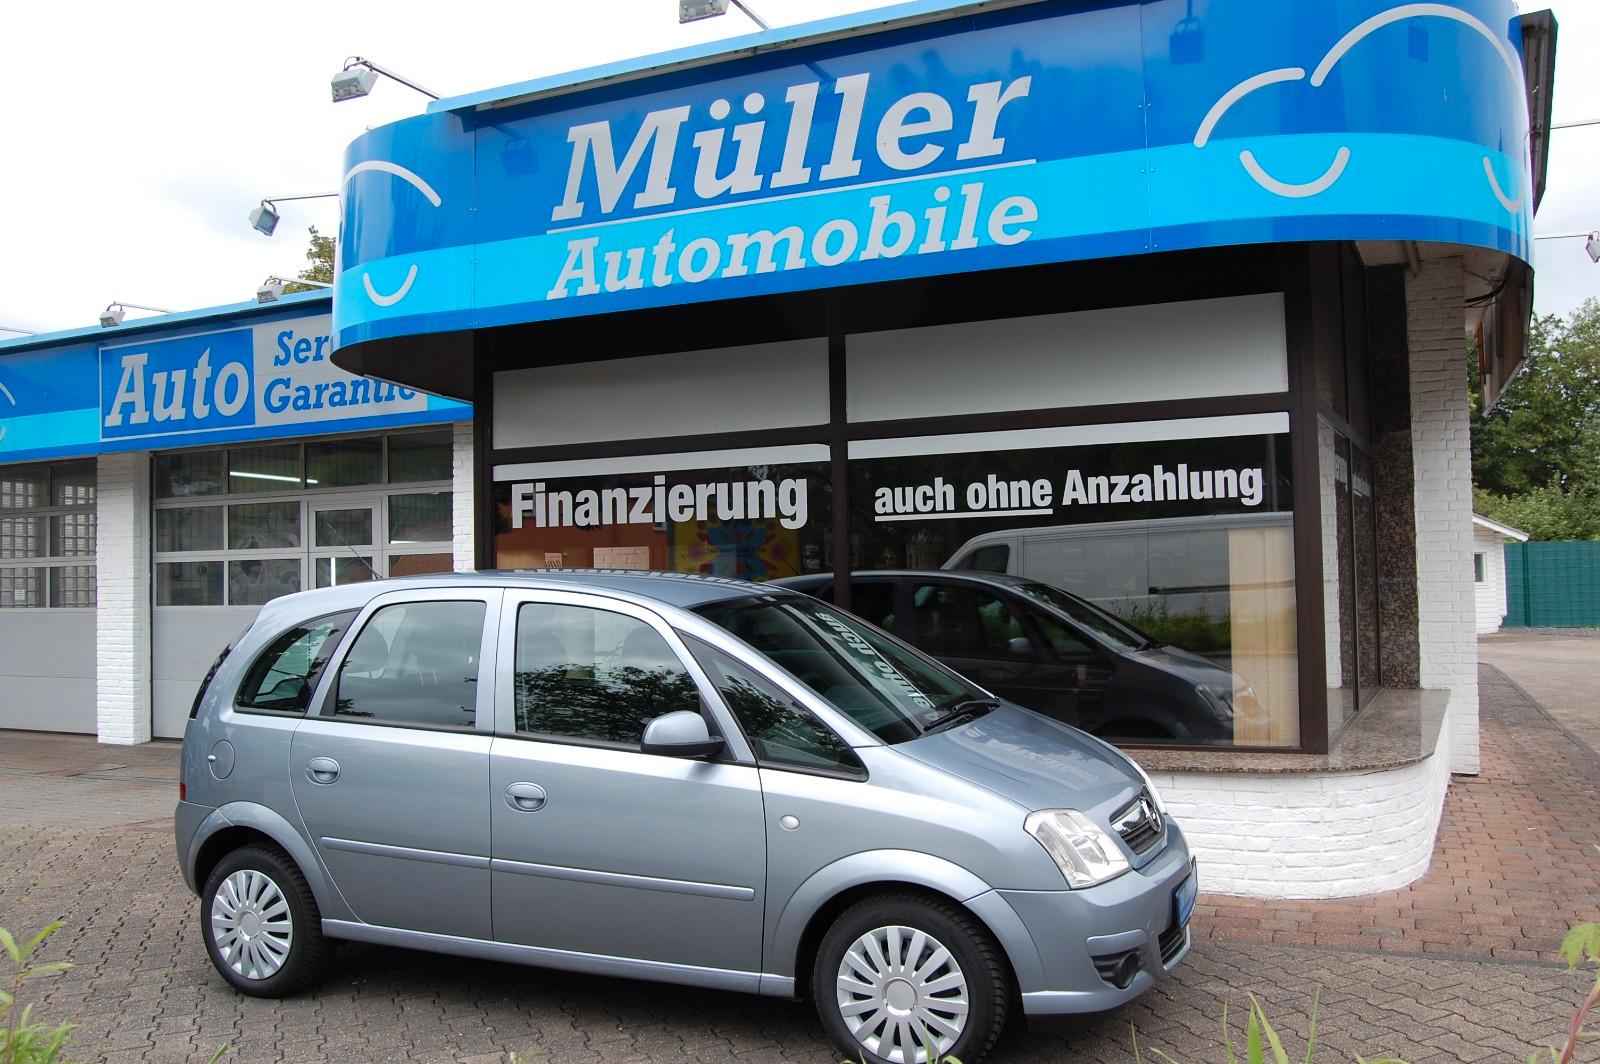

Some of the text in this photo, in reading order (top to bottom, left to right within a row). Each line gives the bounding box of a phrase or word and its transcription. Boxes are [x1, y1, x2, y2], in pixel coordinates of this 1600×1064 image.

[551, 72, 1032, 222] Müller
[547, 182, 1038, 300] Automobile
[274, 329, 330, 367] Ser
[105, 346, 249, 428] Auto
[511, 475, 808, 529] Finanzierung
[874, 463, 1263, 514] auch ohne Anzahlung
